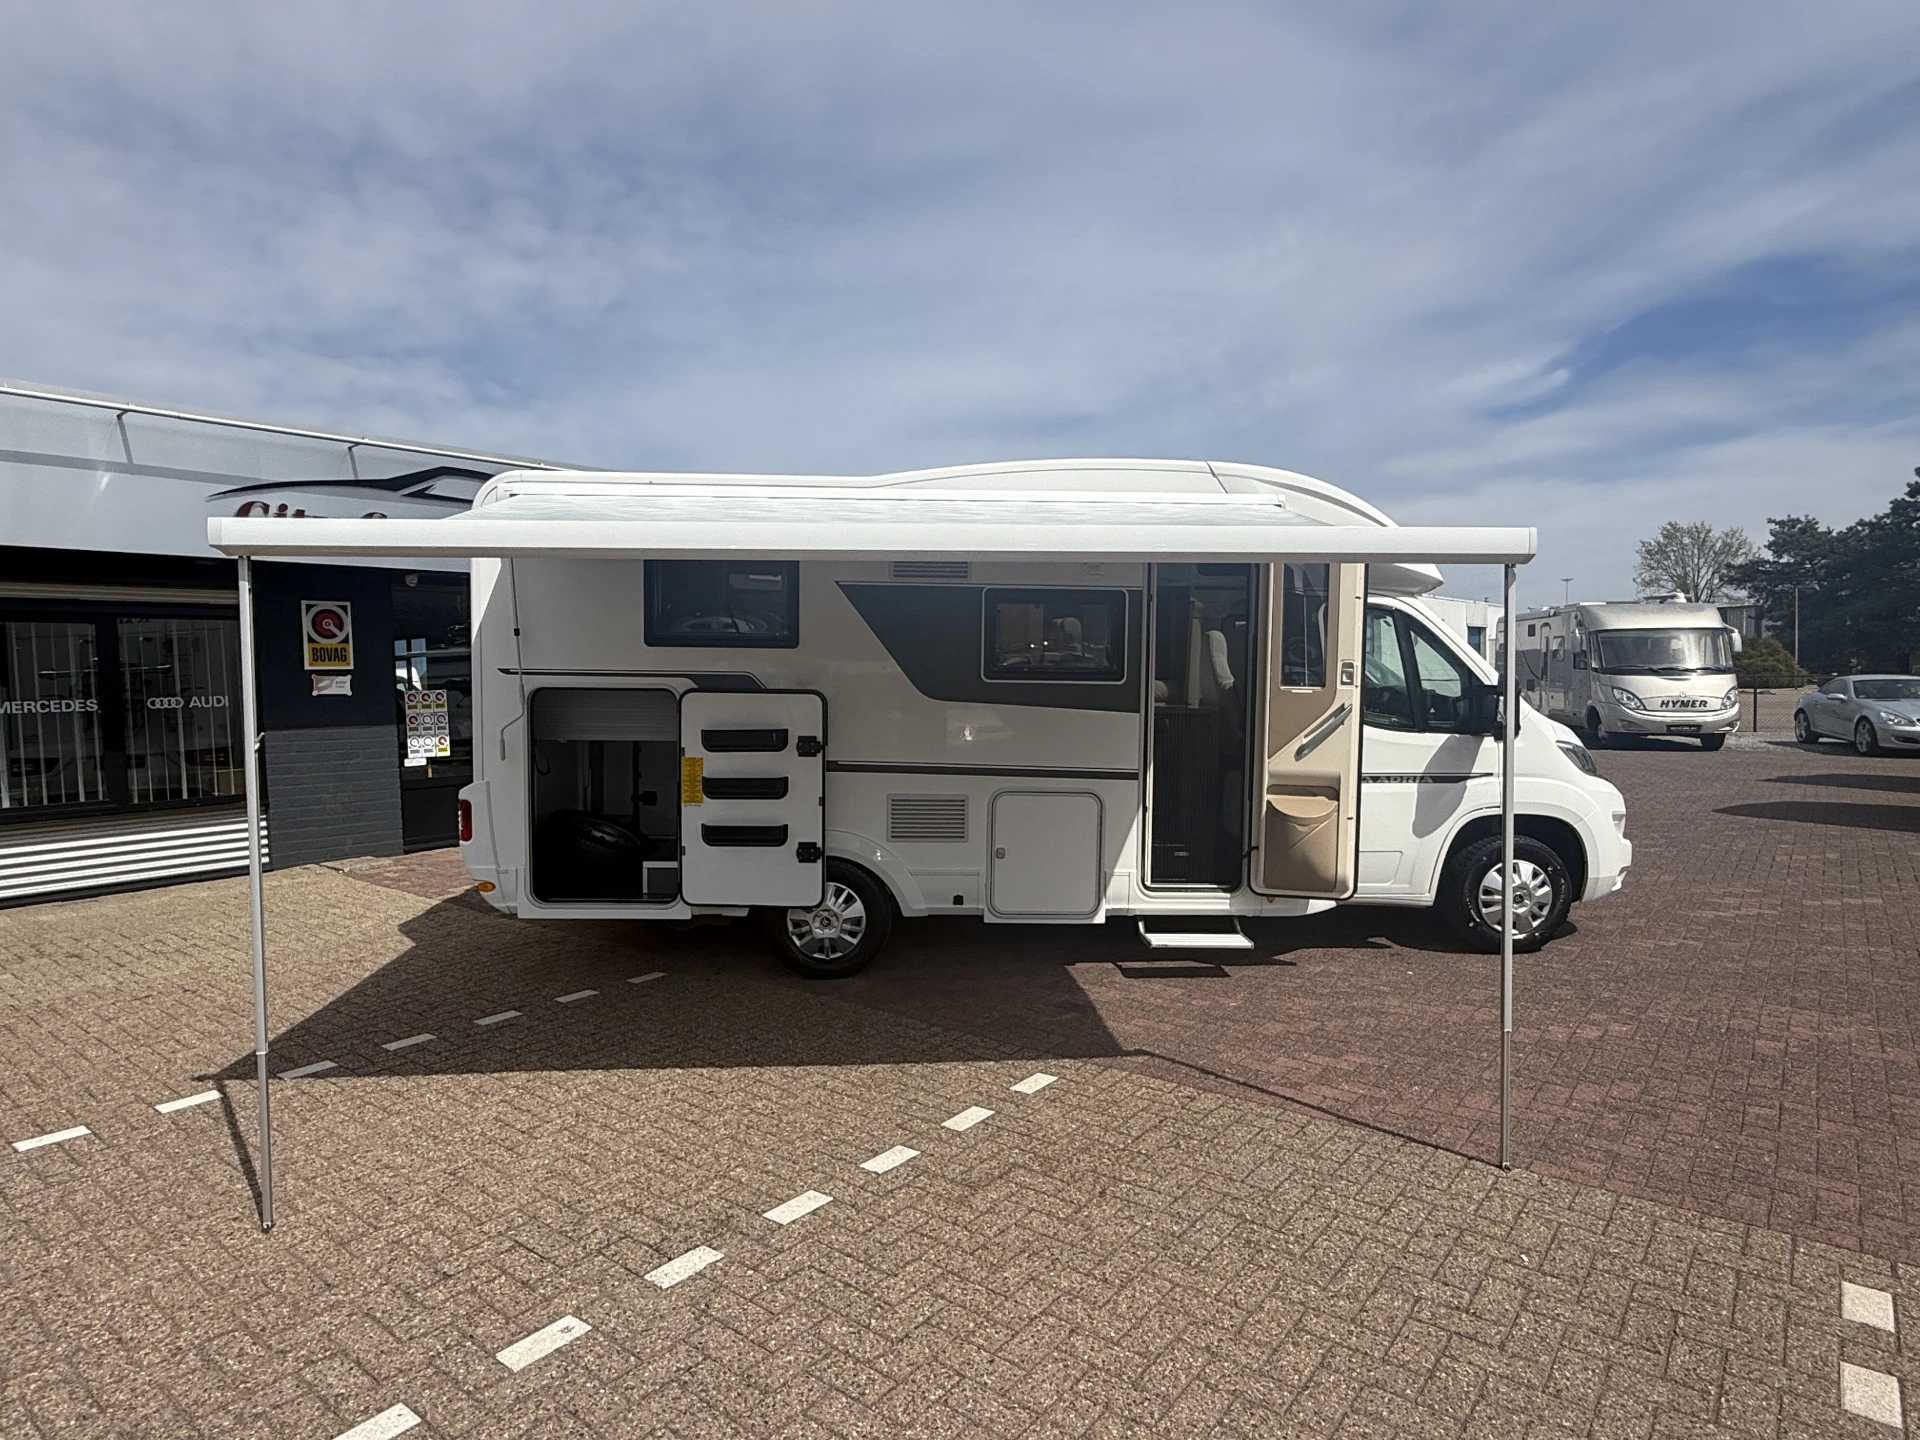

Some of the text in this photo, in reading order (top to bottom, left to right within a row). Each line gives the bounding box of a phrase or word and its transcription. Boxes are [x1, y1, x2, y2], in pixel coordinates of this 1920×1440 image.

[311, 647, 347, 662] BOVAG
[188, 695, 229, 708] AUDI
[1659, 699, 1709, 709] HYMER
[1376, 775, 1434, 784] ADRIA
